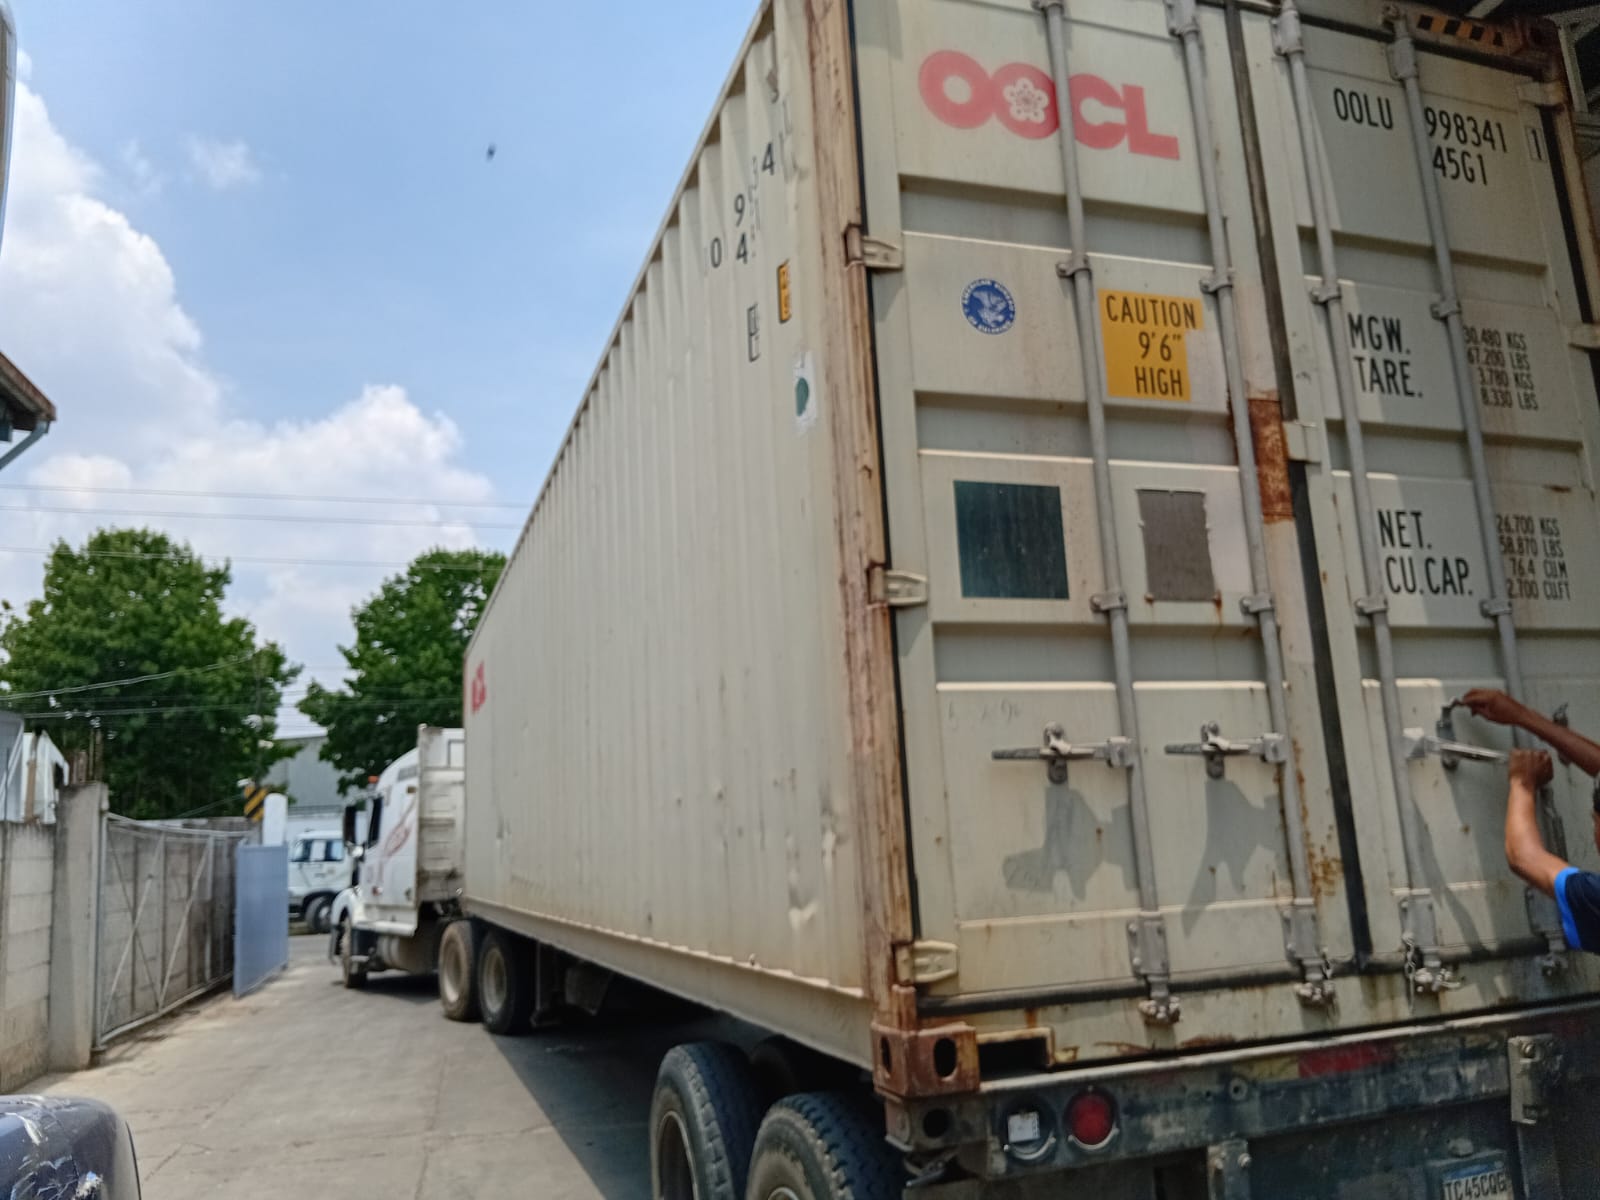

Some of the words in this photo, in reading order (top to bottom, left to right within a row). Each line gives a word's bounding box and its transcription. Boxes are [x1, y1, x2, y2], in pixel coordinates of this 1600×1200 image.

[919, 50, 1180, 160] OOCL
[1424, 106, 1509, 153] 998341
[1432, 145, 1488, 186] 45G1
[1106, 295, 1197, 330] CAUTION
[1347, 312, 1412, 355] MGW.
[1135, 366, 1183, 398] HIGH
[1354, 356, 1424, 399] TARE.
[1377, 509, 1432, 549] NET.
[1385, 556, 1474, 596] CU.CAP.
